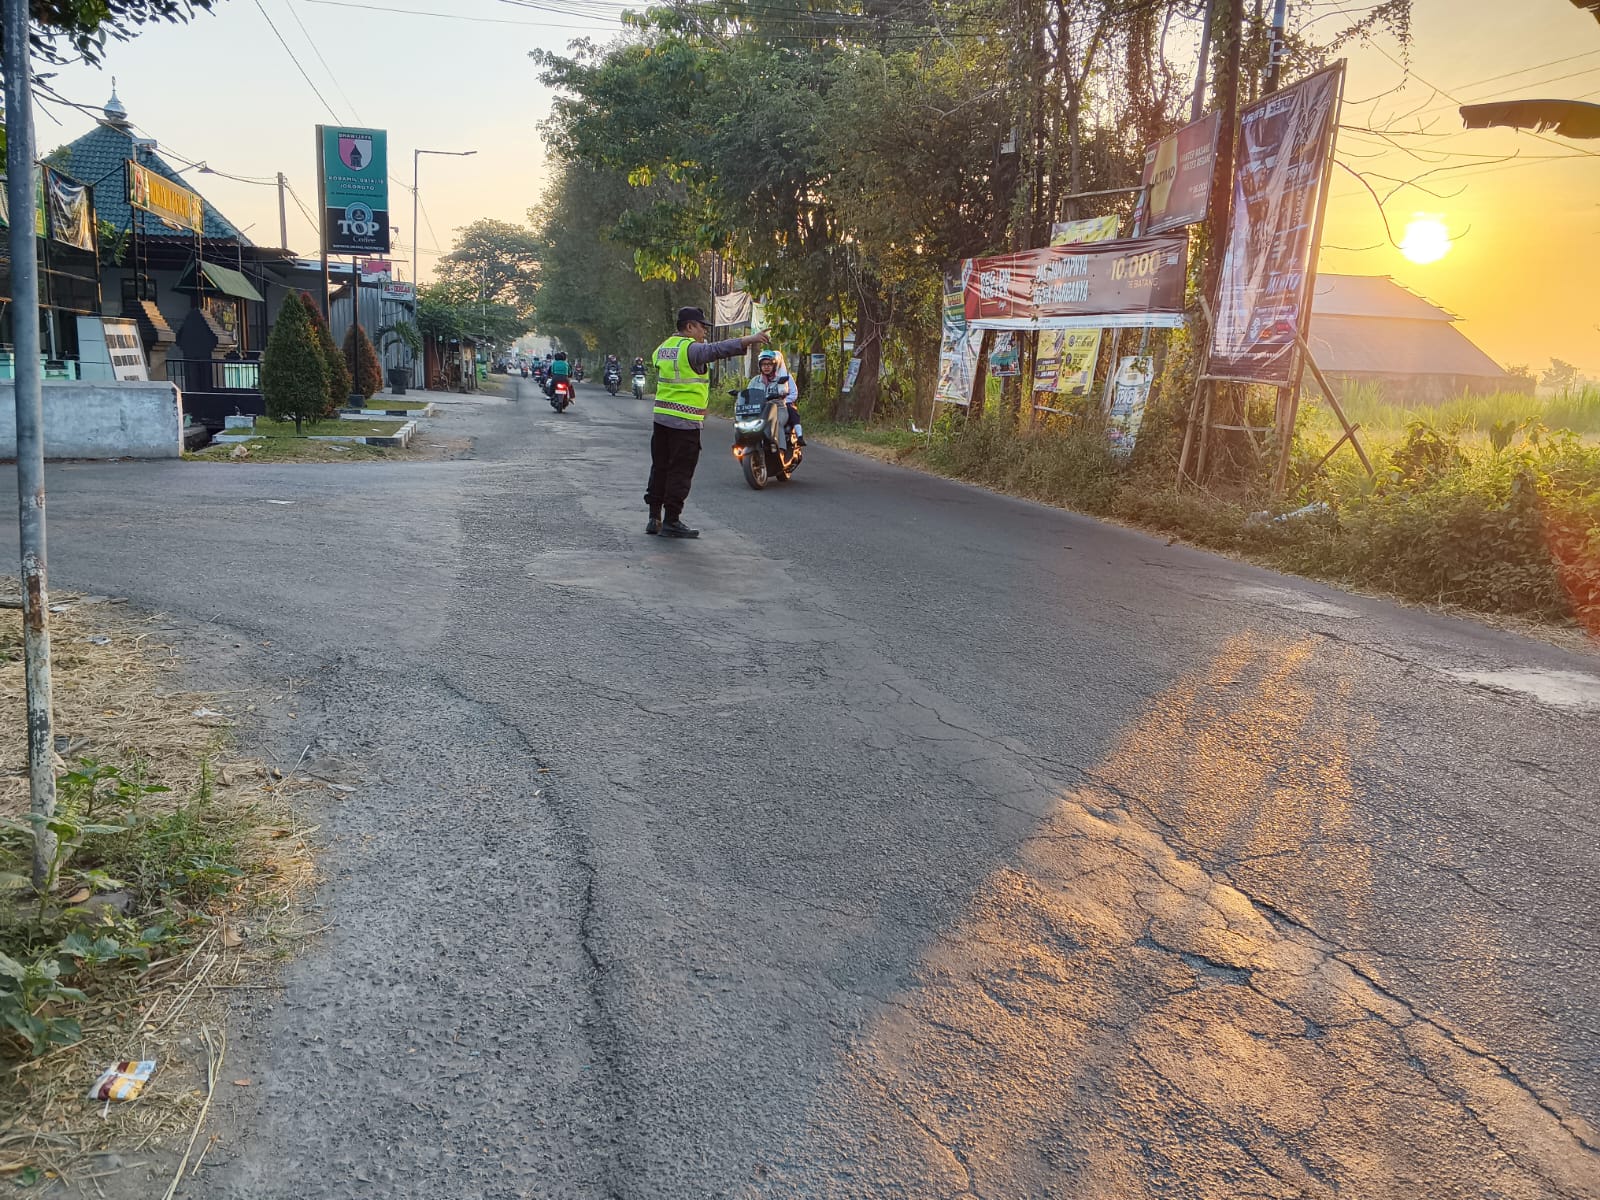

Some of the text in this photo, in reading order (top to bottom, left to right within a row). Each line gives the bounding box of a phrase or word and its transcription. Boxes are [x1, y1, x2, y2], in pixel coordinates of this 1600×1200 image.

[337, 220, 380, 236] TOP
[352, 235, 377, 243] Coffee
[1111, 250, 1161, 280] 10.000
